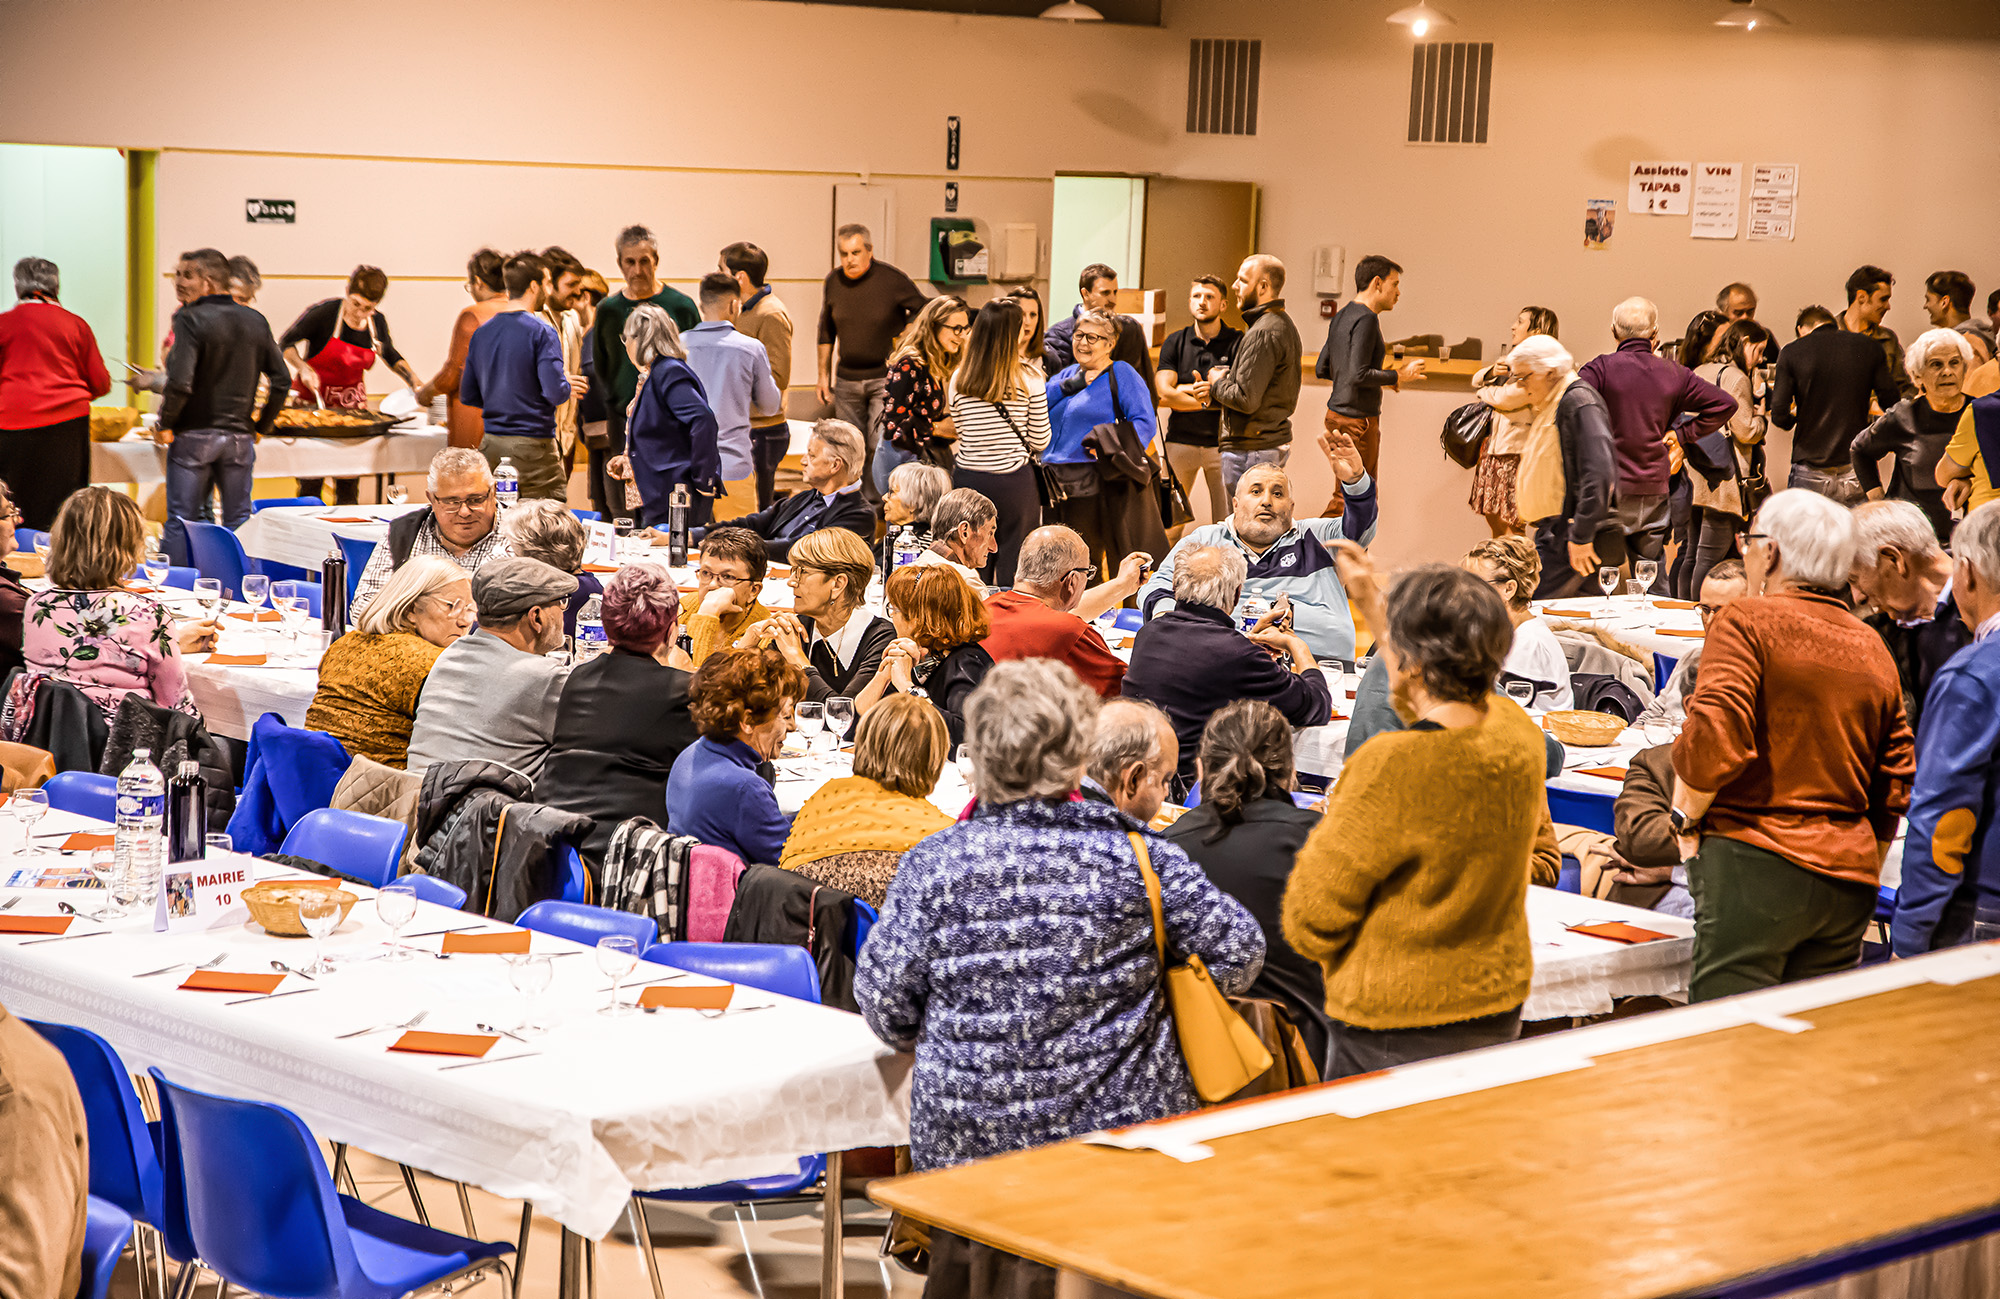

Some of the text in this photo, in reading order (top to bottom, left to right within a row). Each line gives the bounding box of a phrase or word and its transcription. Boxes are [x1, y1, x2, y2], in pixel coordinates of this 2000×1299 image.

[1634, 165, 1689, 176] Assiette
[1705, 167, 1732, 176] VIN
[1639, 182, 1681, 193] TAPAS
[1648, 198, 1668, 209] 2 €
[197, 870, 245, 888] MAIRIE
[215, 893, 231, 906] 10
